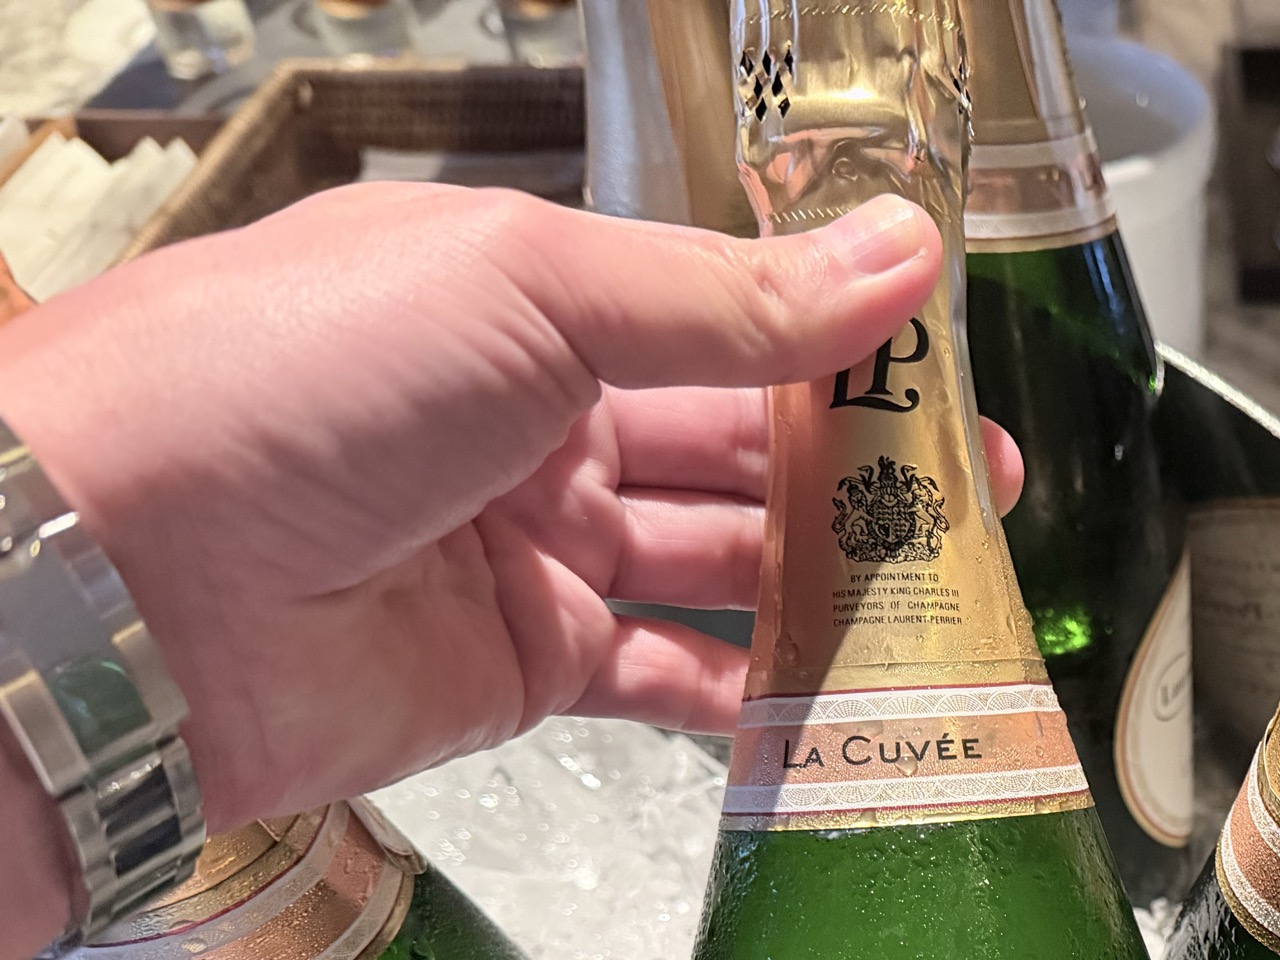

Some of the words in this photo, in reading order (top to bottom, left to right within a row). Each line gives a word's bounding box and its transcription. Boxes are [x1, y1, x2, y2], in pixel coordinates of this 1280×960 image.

[850, 574, 862, 583] BY
[864, 572, 925, 582] APPOINTMENT
[928, 573, 939, 582] TO
[832, 589, 846, 599] HIS
[847, 587, 888, 598] MAJESTY
[890, 586, 911, 596] KING
[913, 587, 950, 597] CHARLES
[833, 601, 884, 613] PURVEYORS
[890, 601, 901, 610] OF
[907, 601, 960, 612] CHAMPAGNE
[833, 615, 886, 628] CHAMPAGNE
[781, 738, 824, 769] LA
[842, 732, 983, 767] CUVÉE
